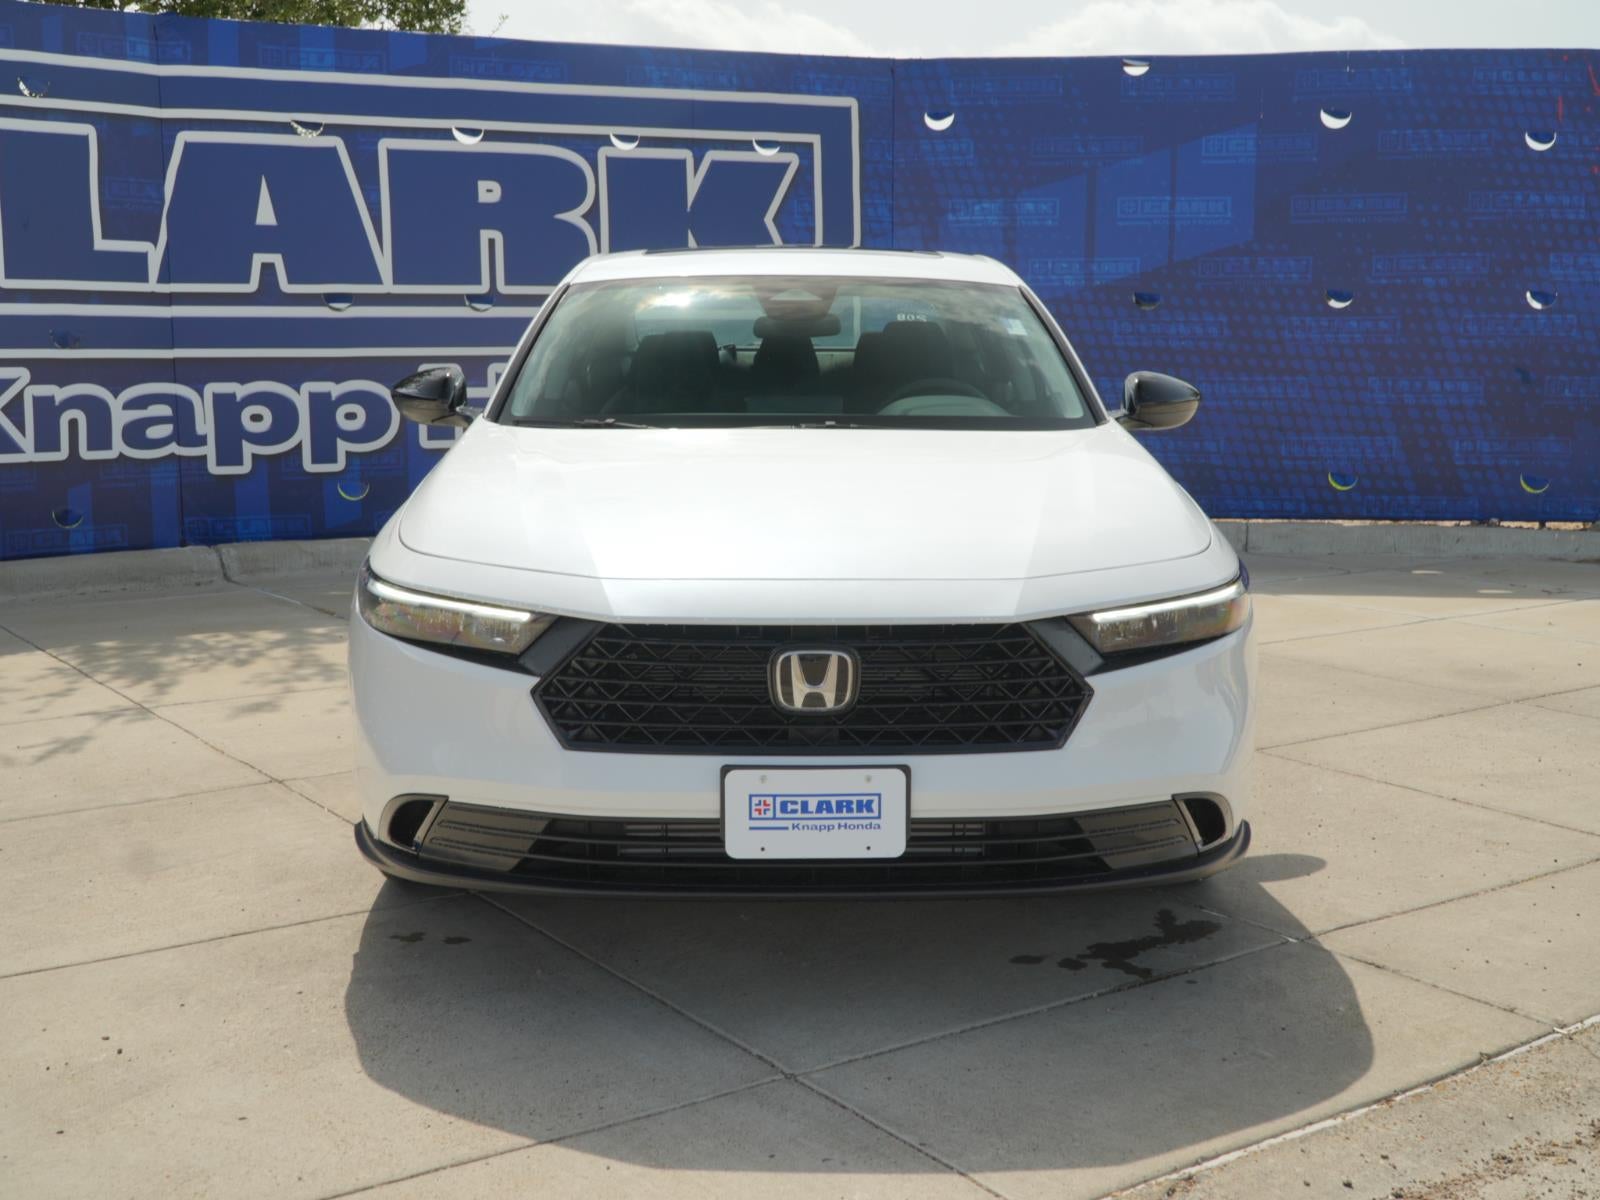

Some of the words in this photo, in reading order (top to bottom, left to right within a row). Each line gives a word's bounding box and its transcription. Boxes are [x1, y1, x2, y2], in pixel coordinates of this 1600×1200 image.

[779, 799, 875, 815] CLARK
[792, 822, 836, 833] Knapp
[837, 820, 881, 831] Honda
